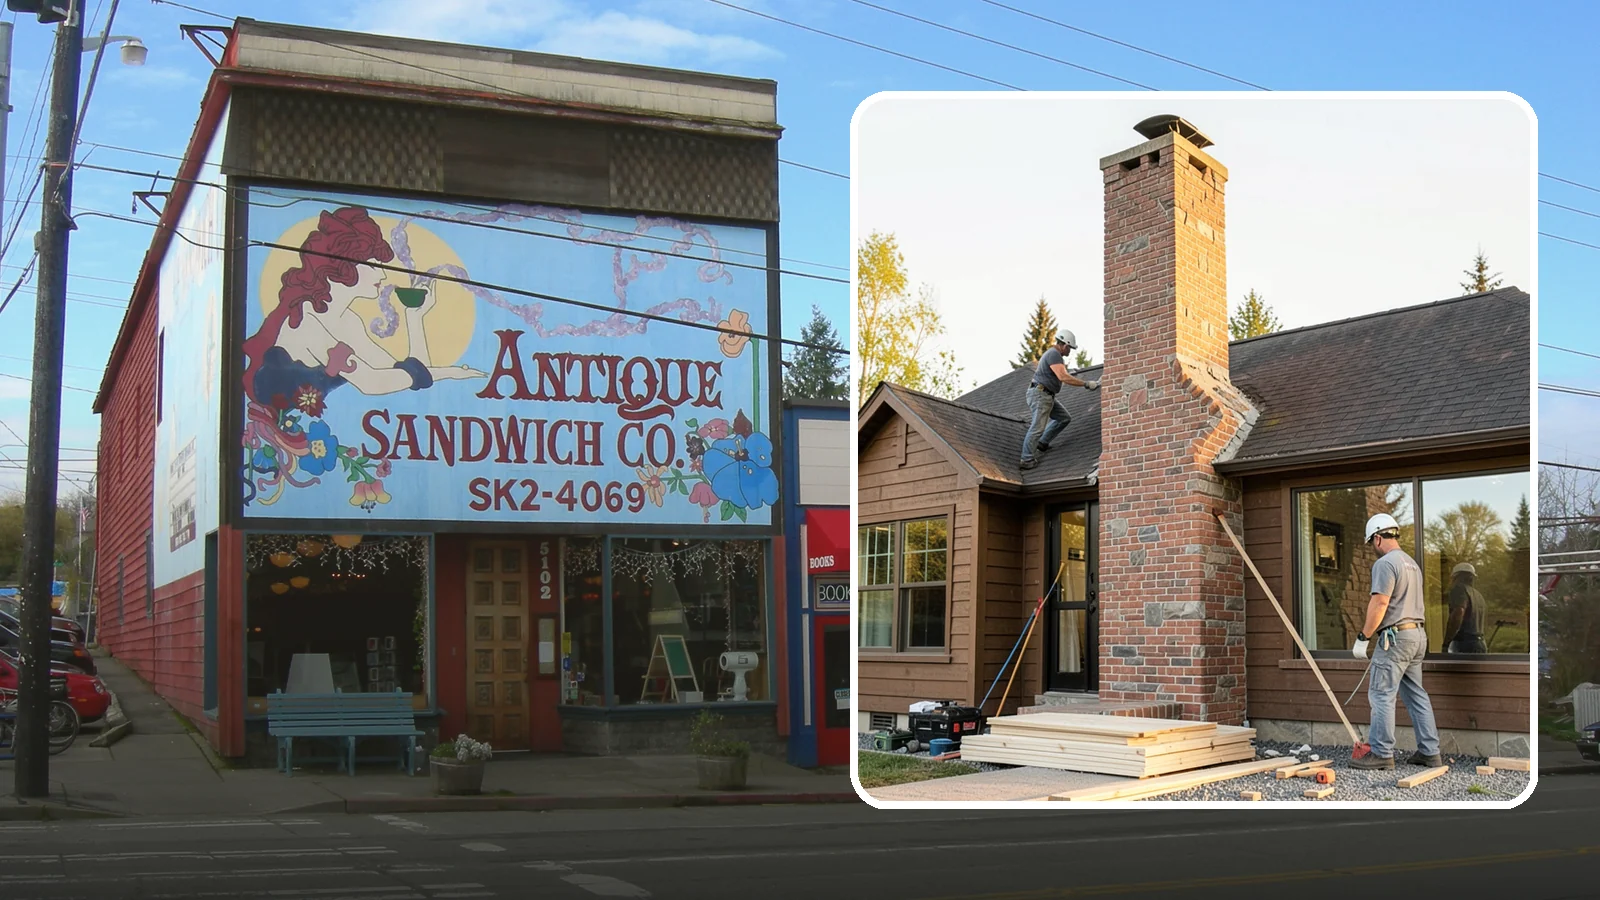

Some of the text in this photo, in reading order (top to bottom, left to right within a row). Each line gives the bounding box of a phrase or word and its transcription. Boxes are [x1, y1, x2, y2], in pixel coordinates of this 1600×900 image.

[475, 329, 723, 420] ANTIQUE
[362, 409, 685, 467] SANDWICH CO.
[468, 477, 645, 512] SK2-4069
[539, 542, 551, 599] 5102
[809, 555, 835, 568] BOOKS
